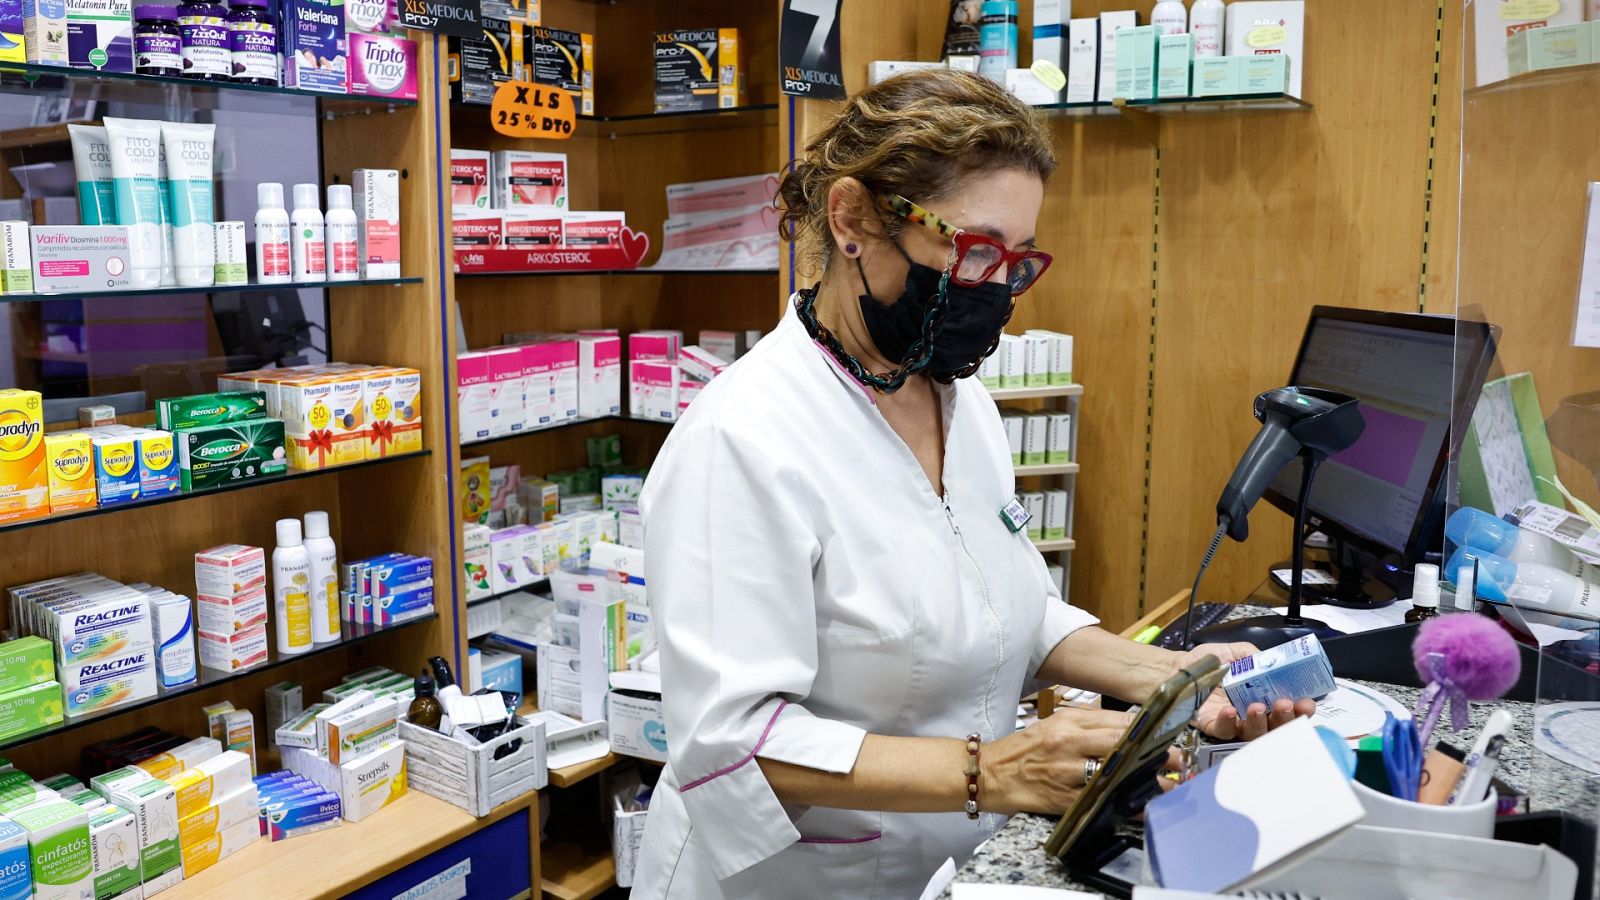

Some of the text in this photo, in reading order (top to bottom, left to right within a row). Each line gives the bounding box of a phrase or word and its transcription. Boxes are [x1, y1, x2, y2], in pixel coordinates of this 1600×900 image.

[297, 7, 338, 26] Valeriana
[350, 3, 385, 18] max
[298, 20, 317, 33] Forte
[192, 39, 221, 47] NATURA
[246, 44, 271, 53] NATURA
[364, 40, 405, 64] Tripto
[368, 62, 404, 78] max
[514, 86, 560, 110] XLS
[542, 117, 572, 135] DTO
[127, 136, 151, 148] FITO
[182, 140, 206, 151] FITO
[125, 147, 156, 158] COLD
[181, 151, 210, 161] COLD
[36, 234, 69, 244] Variliv
[70, 236, 99, 244] Diosmina
[527, 252, 592, 265] ARKOSTEROL
[190, 407, 220, 417] Berocca
[144, 449, 172, 460] Supradyn
[200, 443, 241, 457] Berocca
[54, 455, 89, 469] Supradyn
[104, 455, 133, 466] Supradyn
[75, 604, 141, 627] REACTINE
[80, 653, 146, 678] REACTINE
[357, 761, 390, 784] Strepsils
[319, 804, 339, 813] ilvico
[37, 837, 87, 865] cinfatós
[42, 848, 88, 871] expectorante
[0, 860, 27, 878] atós
